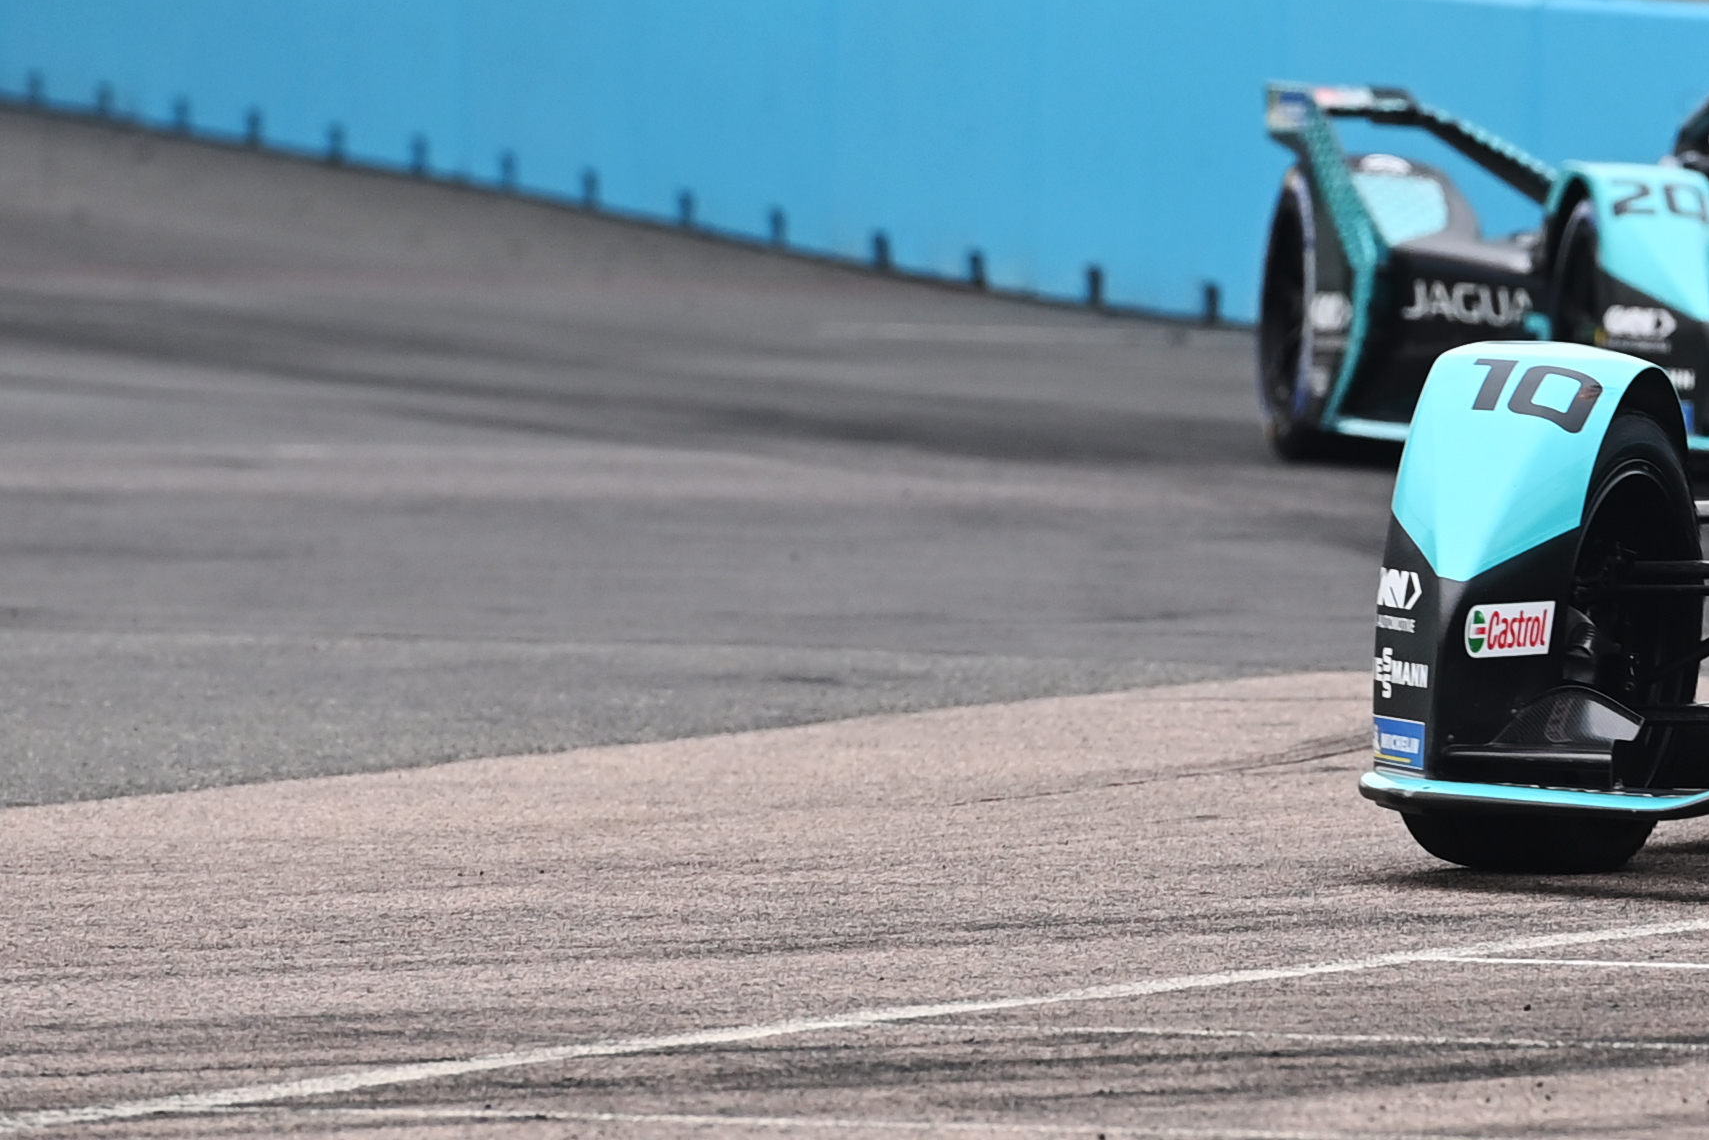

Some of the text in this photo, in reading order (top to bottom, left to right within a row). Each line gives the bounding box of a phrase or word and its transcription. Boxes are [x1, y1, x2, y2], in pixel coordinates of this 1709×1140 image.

[1402, 278, 1534, 328] JAGUA
[1471, 358, 1603, 433] 10
[1487, 608, 1549, 650] Castrol
